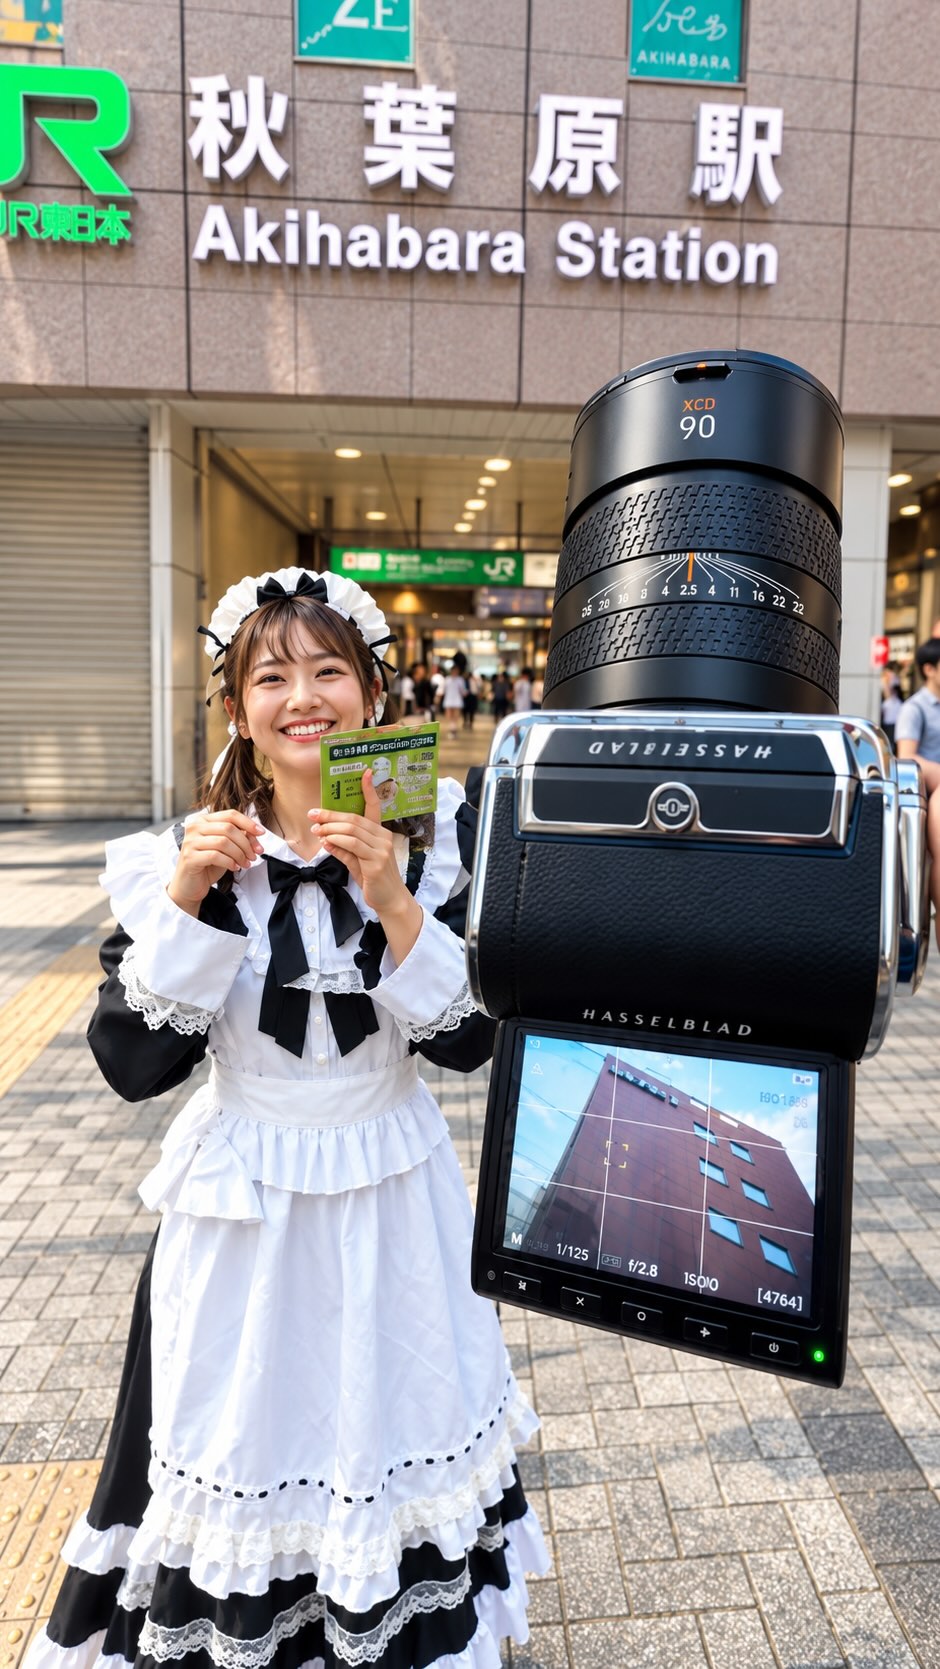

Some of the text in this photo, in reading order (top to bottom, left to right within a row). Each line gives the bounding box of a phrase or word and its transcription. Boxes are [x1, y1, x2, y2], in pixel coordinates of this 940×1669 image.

[637, 49, 731, 70] AKIHABARA
[188, 74, 783, 206] 秋葉原駅
[191, 204, 778, 285] Akihabara Station
[682, 397, 716, 413] XCD
[680, 414, 716, 440] 90
[483, 556, 516, 577] JR
[661, 585, 670, 596] 4
[680, 584, 697, 596] 2.5
[708, 585, 716, 596] 4
[730, 587, 739, 598] 11
[752, 590, 765, 602] 16
[772, 595, 786, 608] 22
[793, 601, 804, 615] 22
[582, 1008, 752, 1036] HASSELBLAD
[511, 1232, 523, 1246] M
[556, 1243, 589, 1261] 1/125
[628, 1259, 658, 1278] f/2.8
[757, 1288, 803, 1311] [4764]
